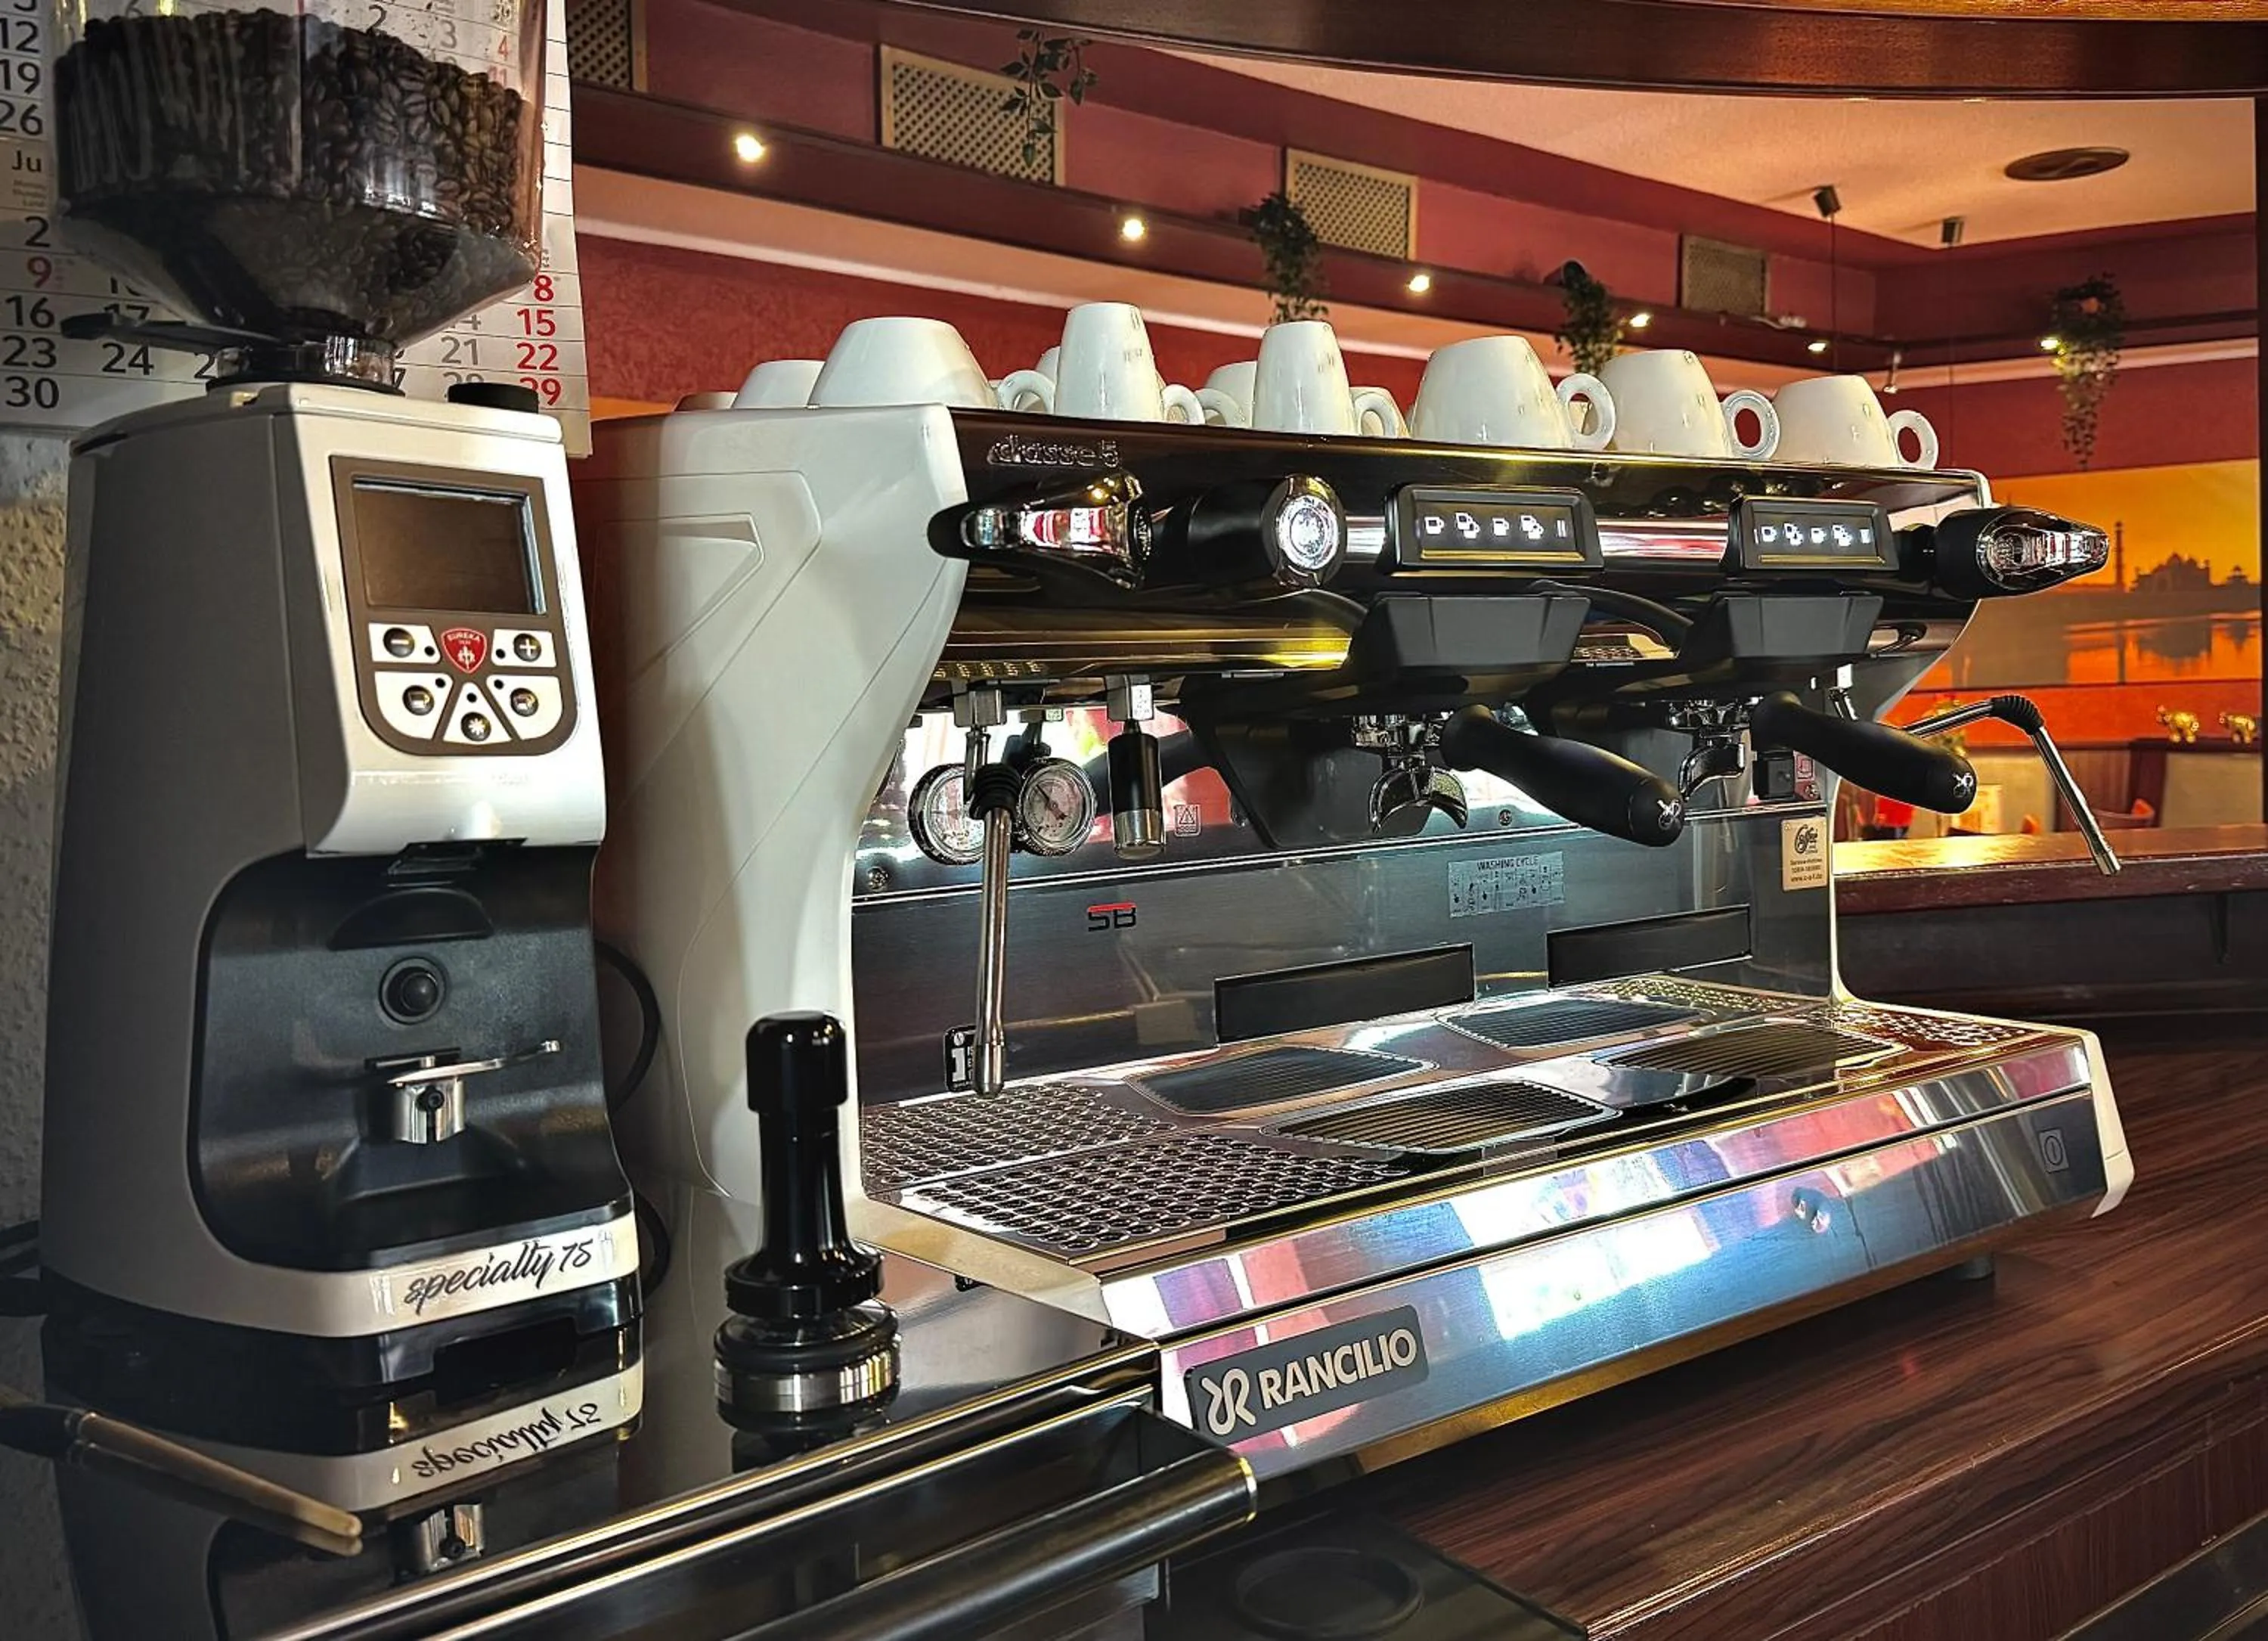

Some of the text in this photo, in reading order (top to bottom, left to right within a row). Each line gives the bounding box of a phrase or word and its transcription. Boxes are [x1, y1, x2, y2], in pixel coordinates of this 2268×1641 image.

[0, 17, 40, 54] 12
[440, 19, 457, 49] 3
[497, 35, 509, 61] 4
[0, 59, 41, 95] 19
[0, 99, 43, 136] 26
[24, 216, 51, 248] 2
[27, 256, 52, 288] 9
[534, 275, 554, 302] 8
[5, 295, 54, 328] 16
[517, 308, 556, 337] 15
[2, 334, 57, 369] 23
[102, 343, 154, 375] 24
[441, 336, 479, 366] 21
[516, 342, 559, 371] 22
[5, 376, 60, 408] 30
[1476, 855, 1539, 870] WASHING CYCLE
[404, 1239, 593, 1315] specialty 75
[1258, 1328, 1418, 1410] RANCILIO
